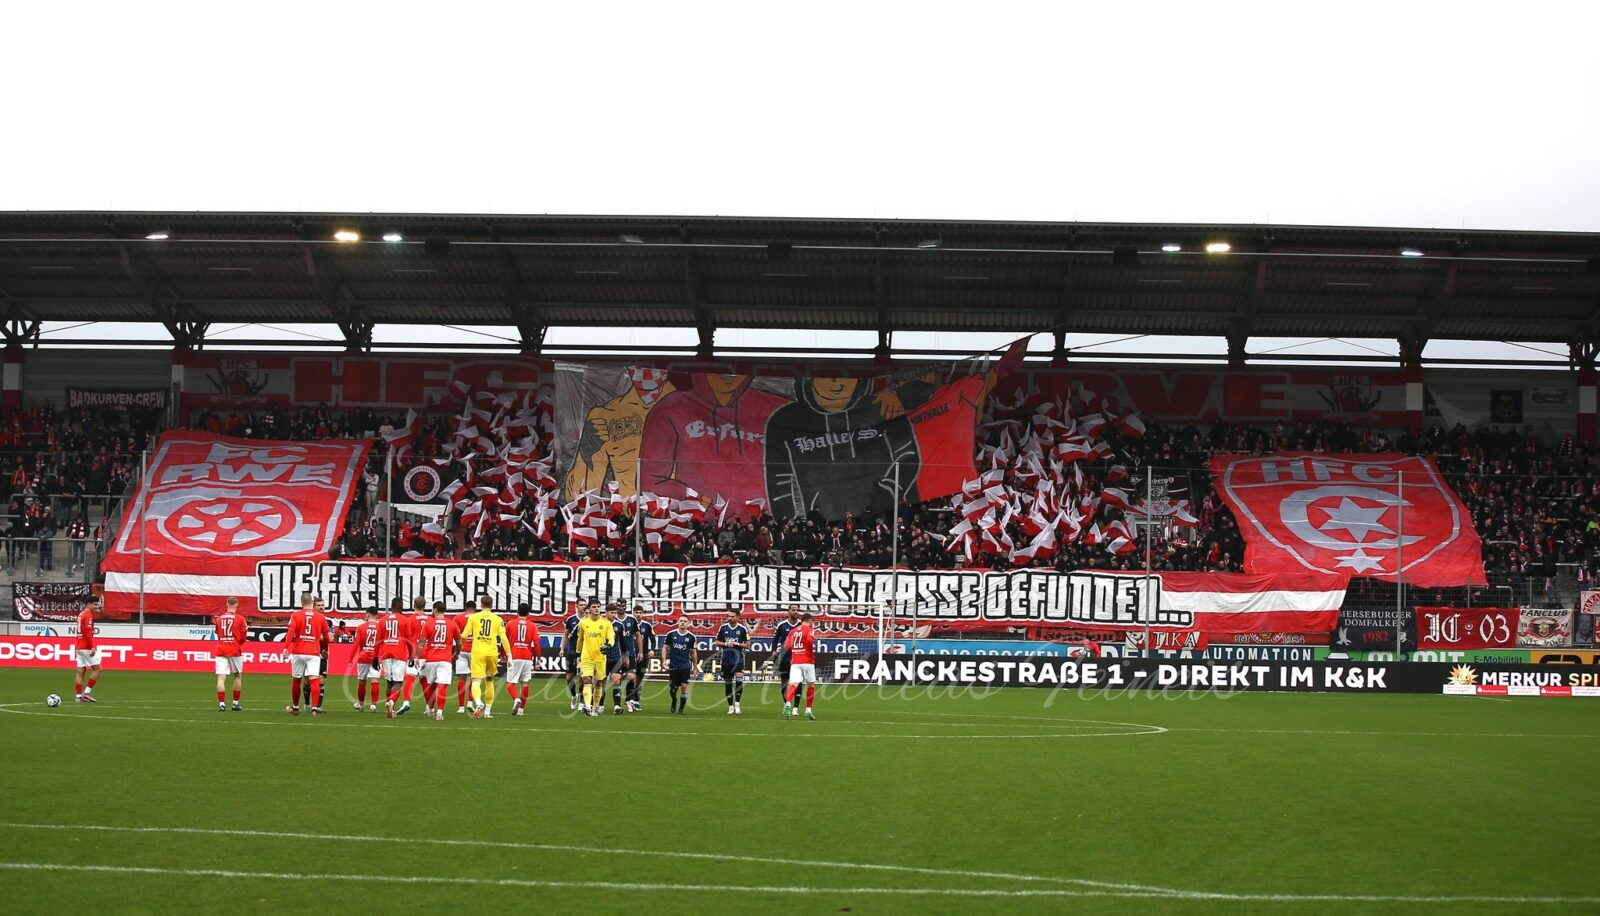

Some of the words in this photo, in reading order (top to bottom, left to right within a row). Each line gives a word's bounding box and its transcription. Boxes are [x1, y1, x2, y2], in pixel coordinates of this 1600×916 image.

[69, 390, 165, 408] BADKURVEN-CREW
[205, 442, 308, 463] FC
[159, 463, 337, 485] RWE
[1261, 457, 1398, 483] HFC
[259, 564, 313, 611] DIE
[320, 564, 571, 614] FREUNDSCHAFT
[577, 566, 677, 615] EINST
[684, 568, 750, 613] AUF
[755, 568, 822, 615] DER
[827, 568, 980, 620] STRASSE
[1521, 609, 1567, 617] FANCLUB
[220, 619, 233, 637] 42
[305, 616, 312, 635] 5
[385, 620, 398, 638] 40
[479, 619, 492, 637] 30
[1345, 619, 1405, 627] DOMFALKEN
[365, 629, 377, 646] 23
[433, 624, 447, 642] 28
[517, 624, 527, 642] 10
[793, 632, 803, 648] 22
[1362, 630, 1389, 645] 1982
[0, 642, 132, 663] DSCHFT
[152, 650, 178, 661] SEI
[1202, 648, 1311, 660] AUTOMATION
[834, 659, 1098, 684] FRANCKESTRAßE
[1107, 664, 1125, 684] 1
[1158, 665, 1270, 688] DIREKT
[1279, 666, 1316, 688] IM
[1323, 666, 1388, 689] K&K
[1482, 671, 1562, 687] MERKUR
[1569, 672, 1600, 687] SPI
